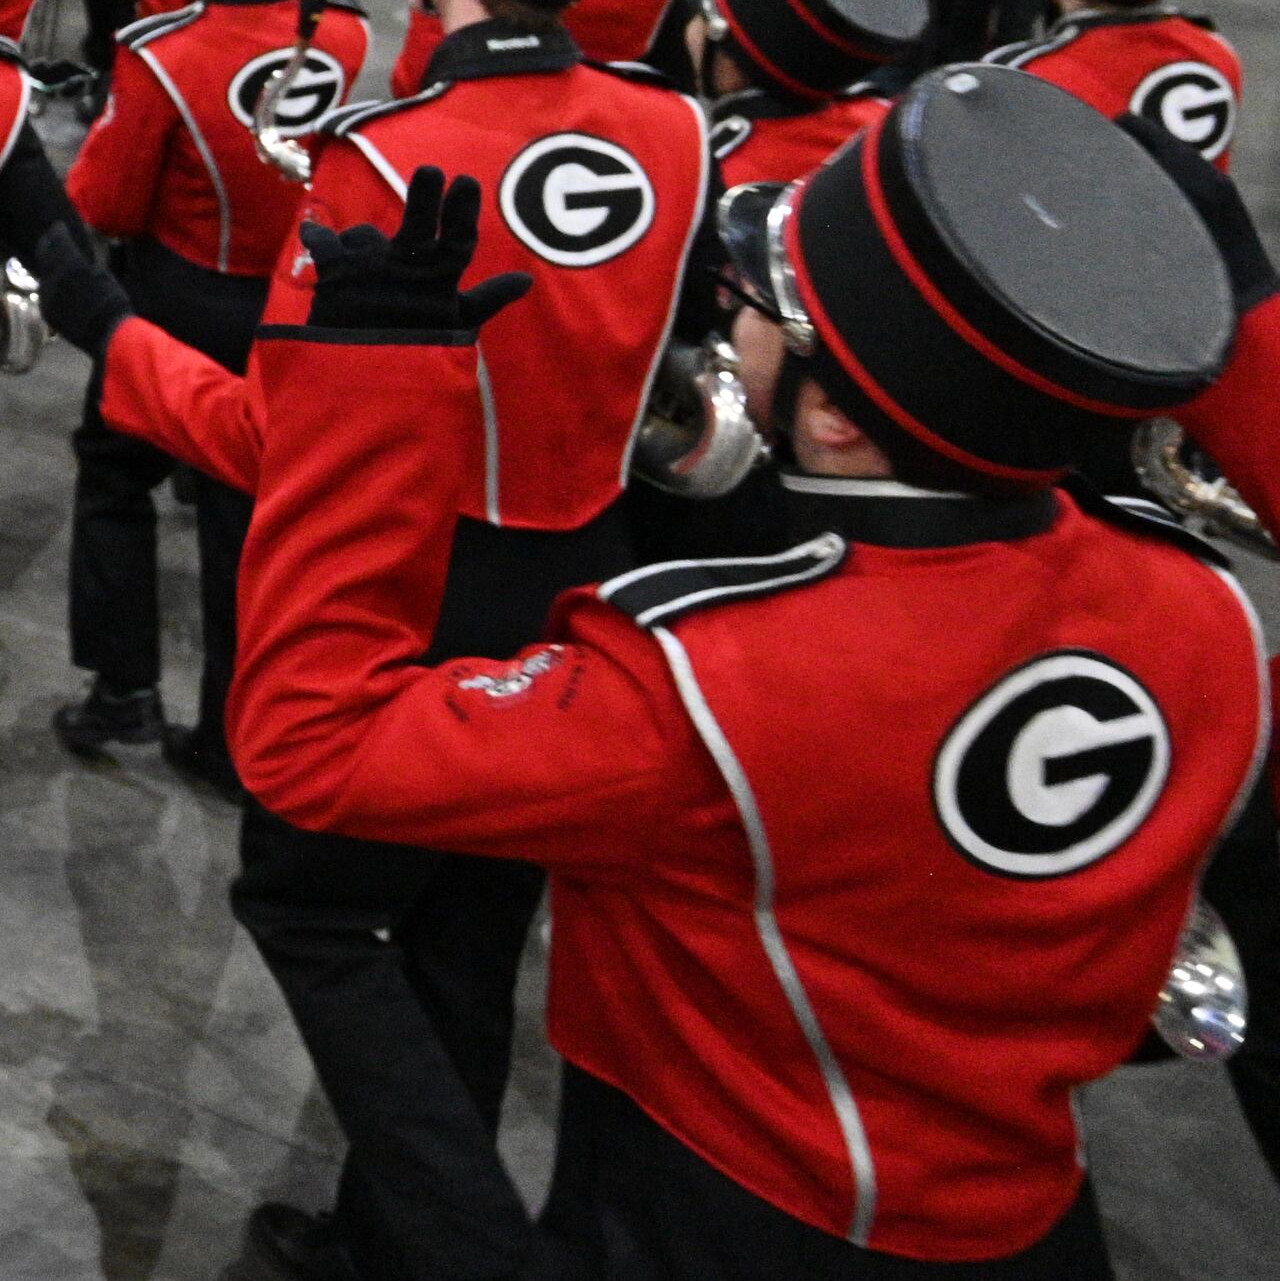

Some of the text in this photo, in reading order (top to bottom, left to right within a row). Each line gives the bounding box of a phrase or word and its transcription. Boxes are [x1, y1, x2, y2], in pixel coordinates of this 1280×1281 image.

[235, 55, 339, 129] G
[1138, 70, 1231, 153] G
[510, 143, 647, 255] G
[951, 671, 1158, 859] G
